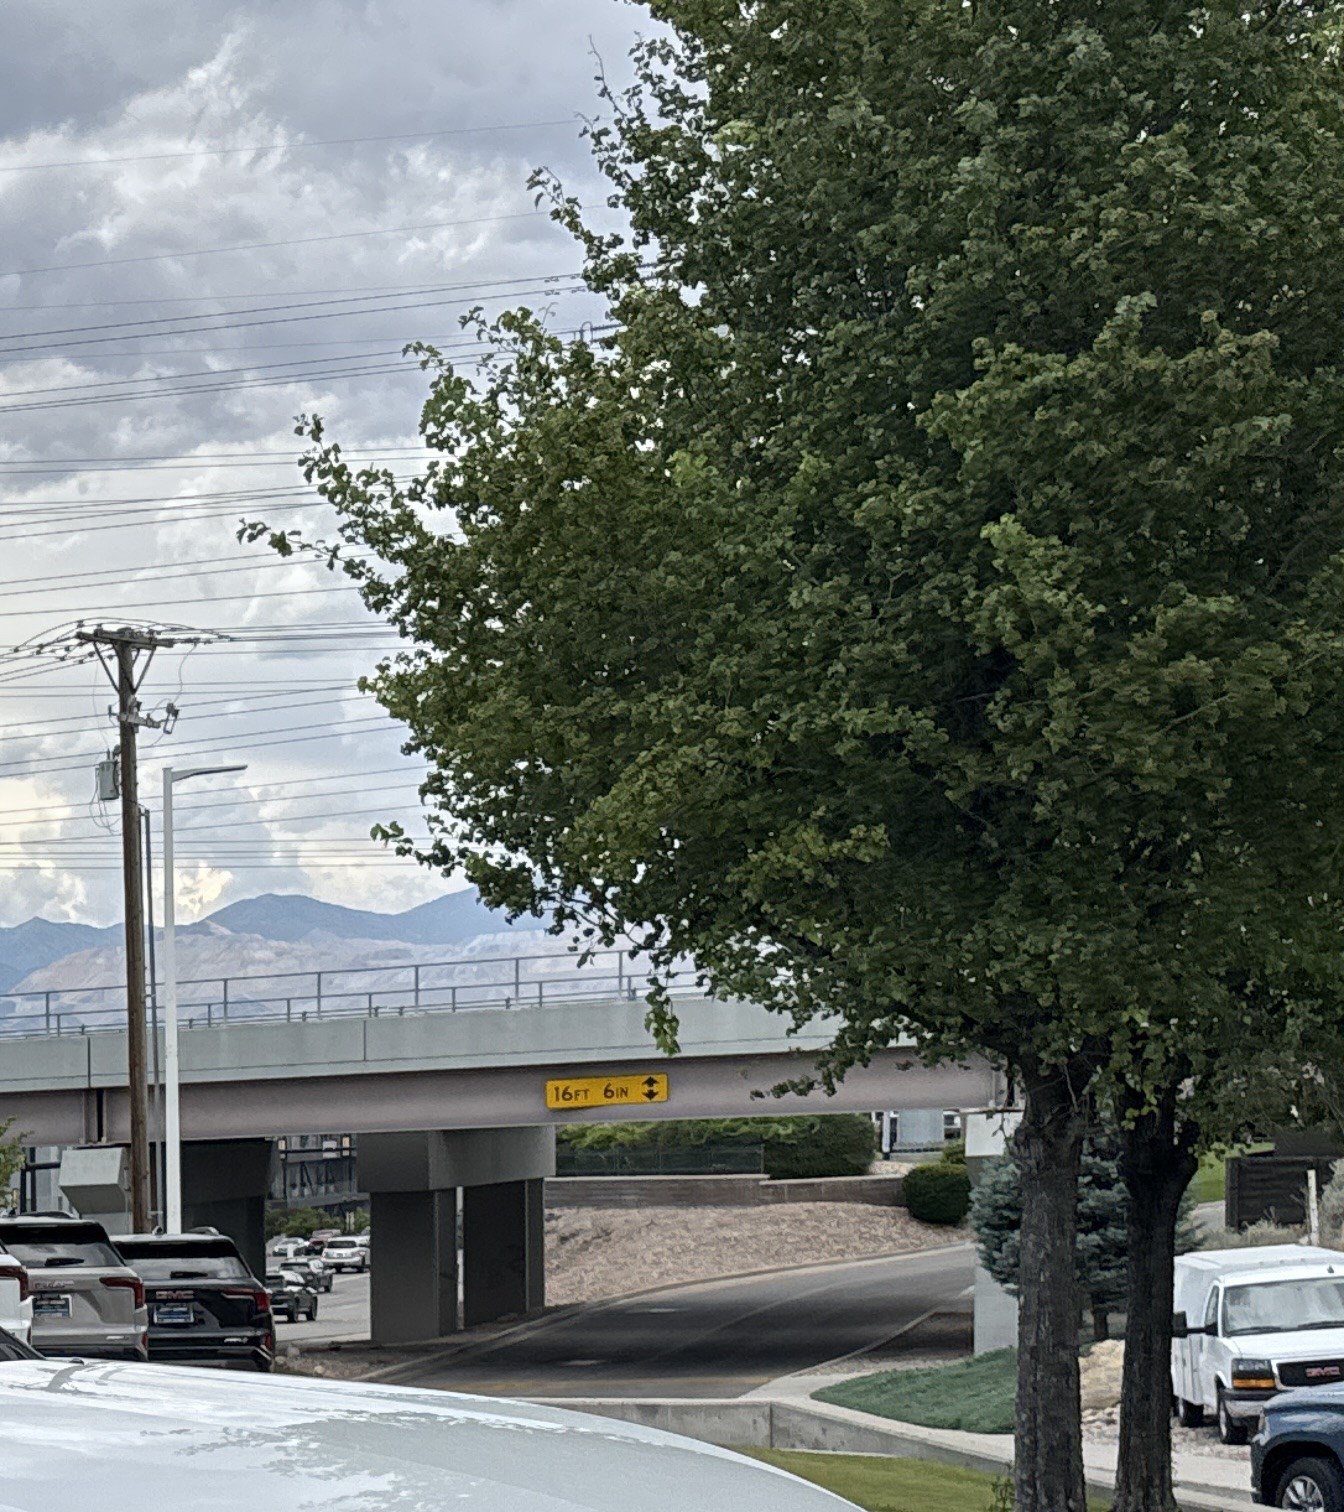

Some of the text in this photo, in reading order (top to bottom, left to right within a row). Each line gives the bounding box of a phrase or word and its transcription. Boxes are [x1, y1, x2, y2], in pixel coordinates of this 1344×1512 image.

[554, 1083, 629, 1102] 16FT 6IN
[155, 1290, 194, 1300] GMC
